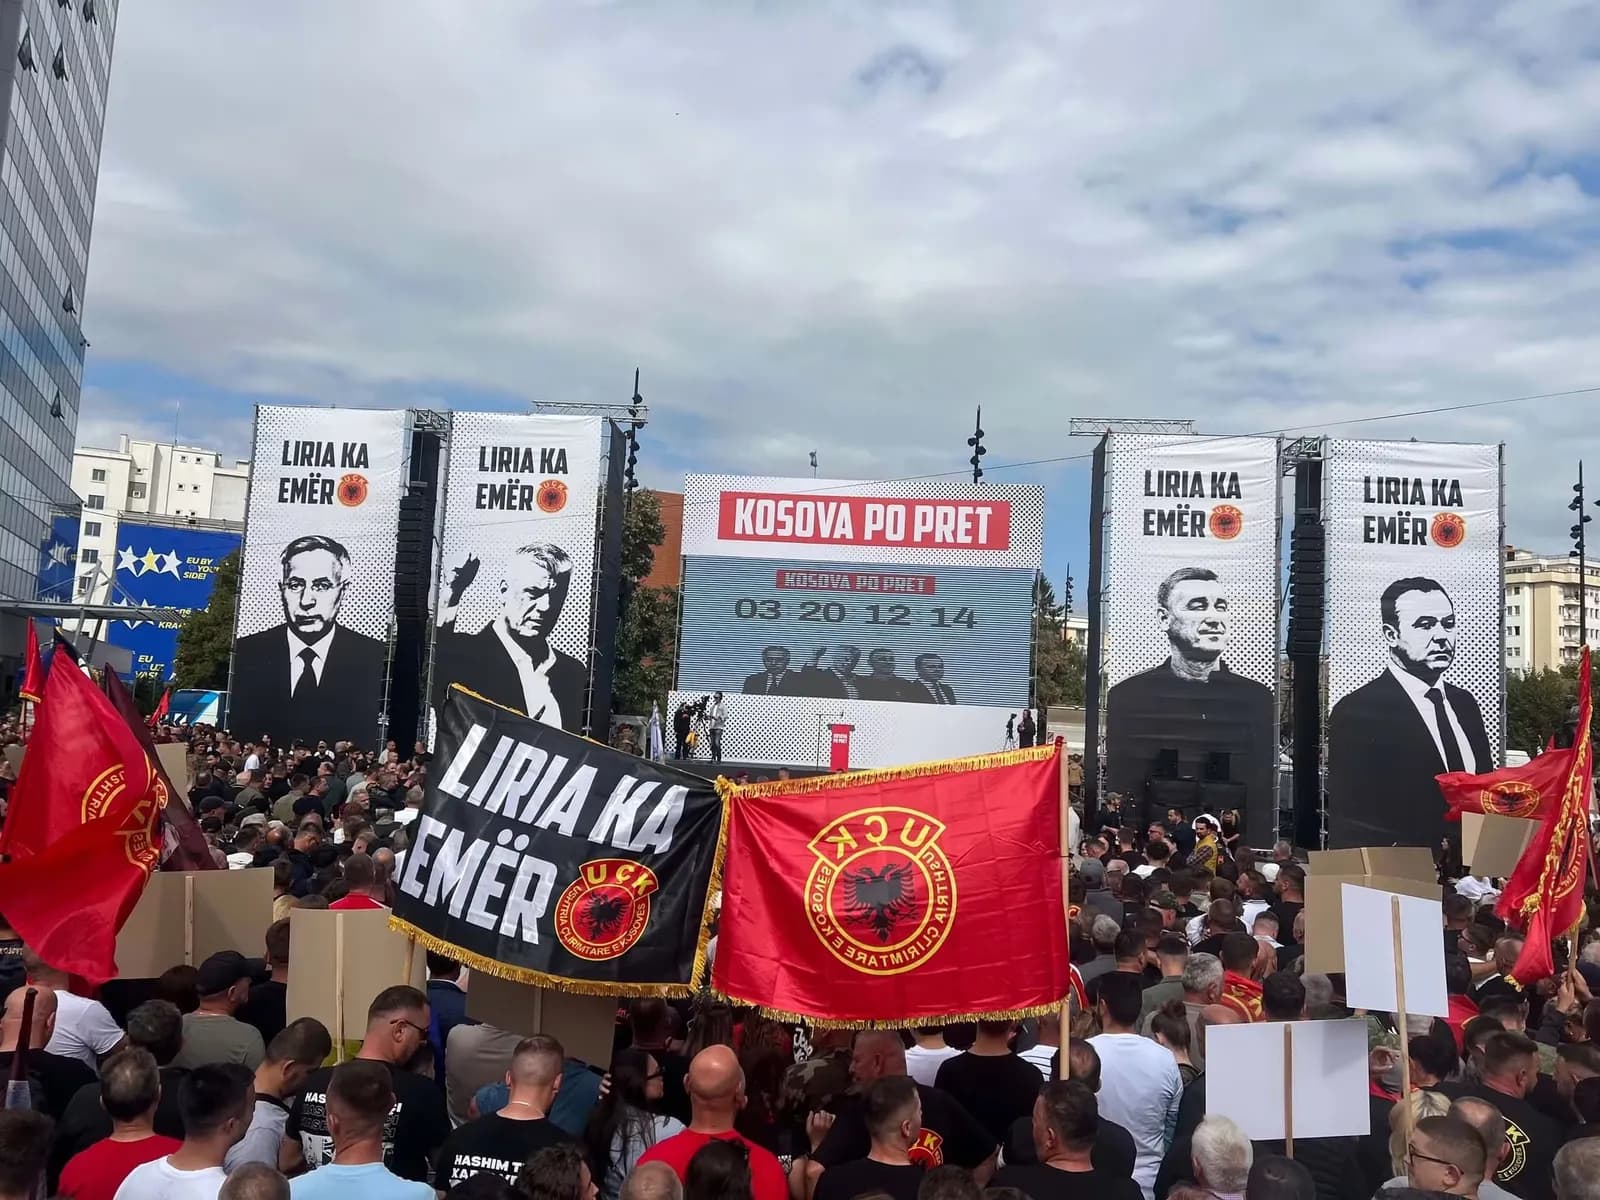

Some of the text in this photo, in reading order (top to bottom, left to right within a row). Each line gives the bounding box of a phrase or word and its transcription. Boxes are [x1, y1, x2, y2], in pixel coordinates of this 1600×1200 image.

[282, 440, 369, 468] LIRIA KA
[479, 446, 568, 474] LIRIA KA
[278, 472, 335, 505] EMËR
[476, 479, 534, 511] EMËR
[1144, 470, 1242, 499] LIRIA KA
[1364, 476, 1463, 507] LIRIA KA
[734, 498, 992, 545] KOSOVA PO PRET
[1143, 503, 1206, 538] EMËR
[1363, 510, 1428, 546] EMËR
[186, 556, 200, 564] EU
[784, 571, 926, 592] KOSOVA PO PRET
[734, 597, 978, 629] 03 20 12 14
[138, 654, 154, 663] EU
[438, 724, 690, 855] LIRIA KA
[400, 814, 558, 946] EMËR
[586, 863, 655, 896] UÇK
[559, 885, 583, 927] USHTRIA
[454, 1154, 509, 1172] HASHIM
